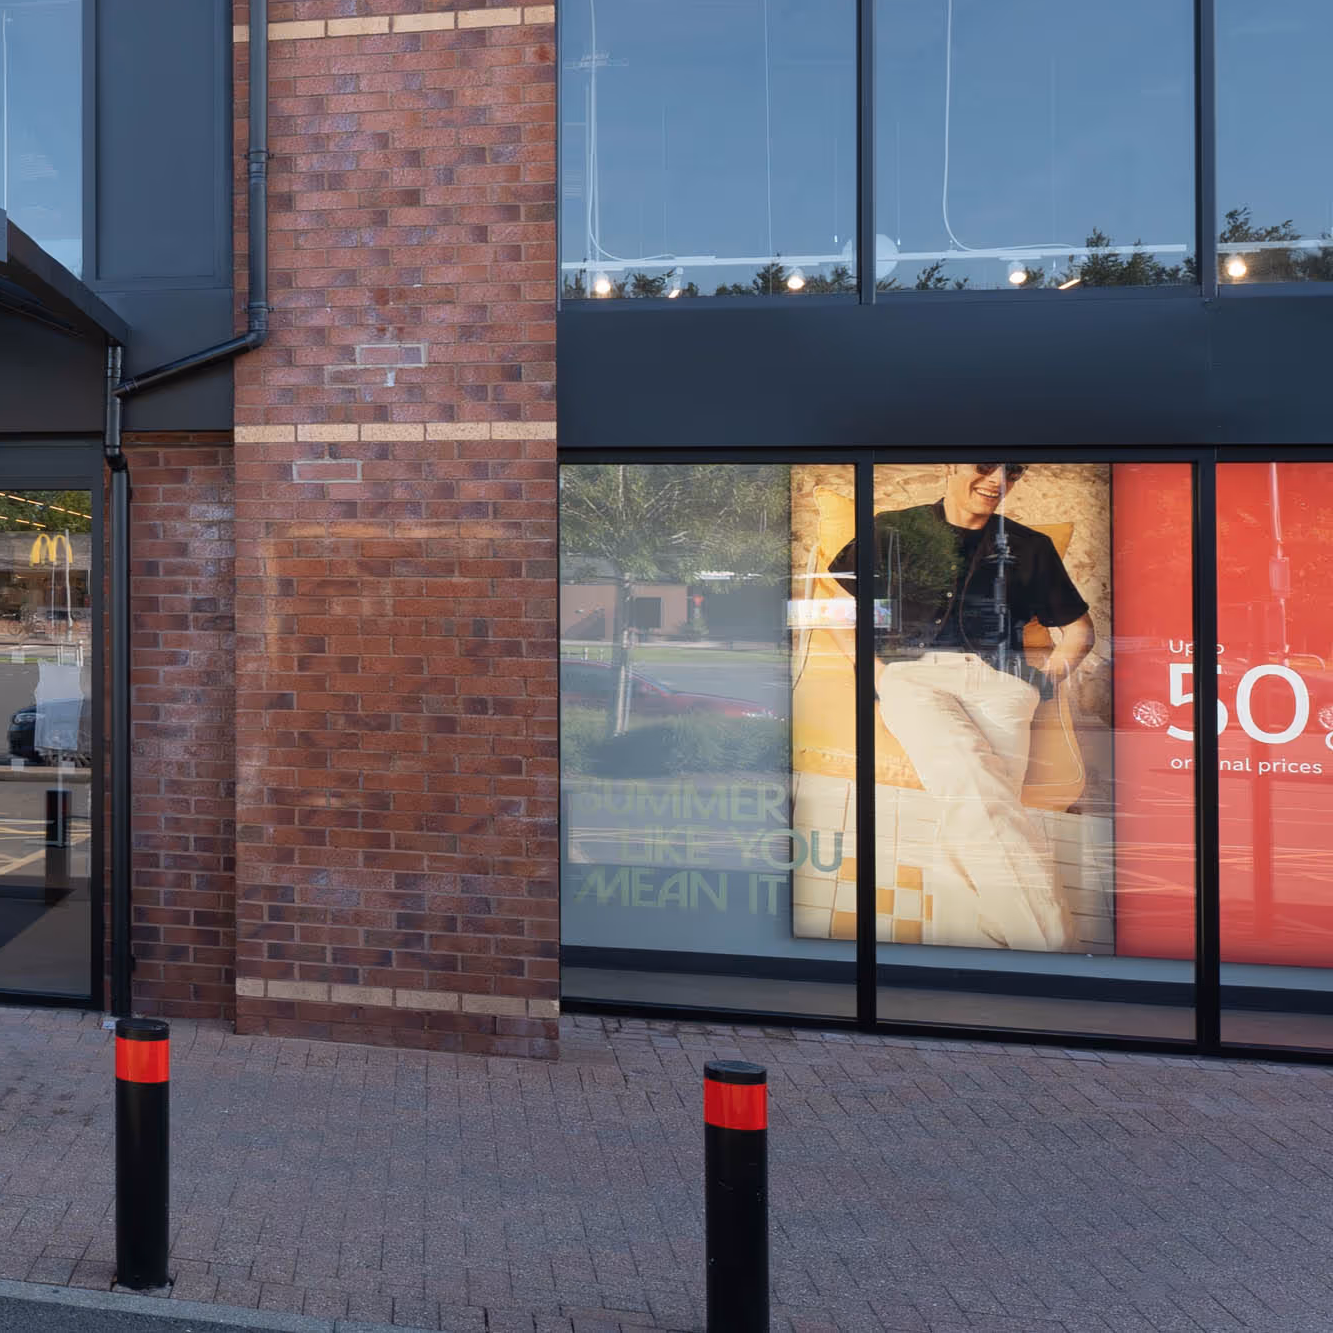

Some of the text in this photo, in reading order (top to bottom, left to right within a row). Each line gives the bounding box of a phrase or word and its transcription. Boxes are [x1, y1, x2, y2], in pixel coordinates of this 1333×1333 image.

[1170, 758, 1323, 775] ornal prices
[573, 775, 789, 824] SUMMER
[619, 824, 845, 873] LIKE YOU
[573, 868, 788, 916] MEAN IT
